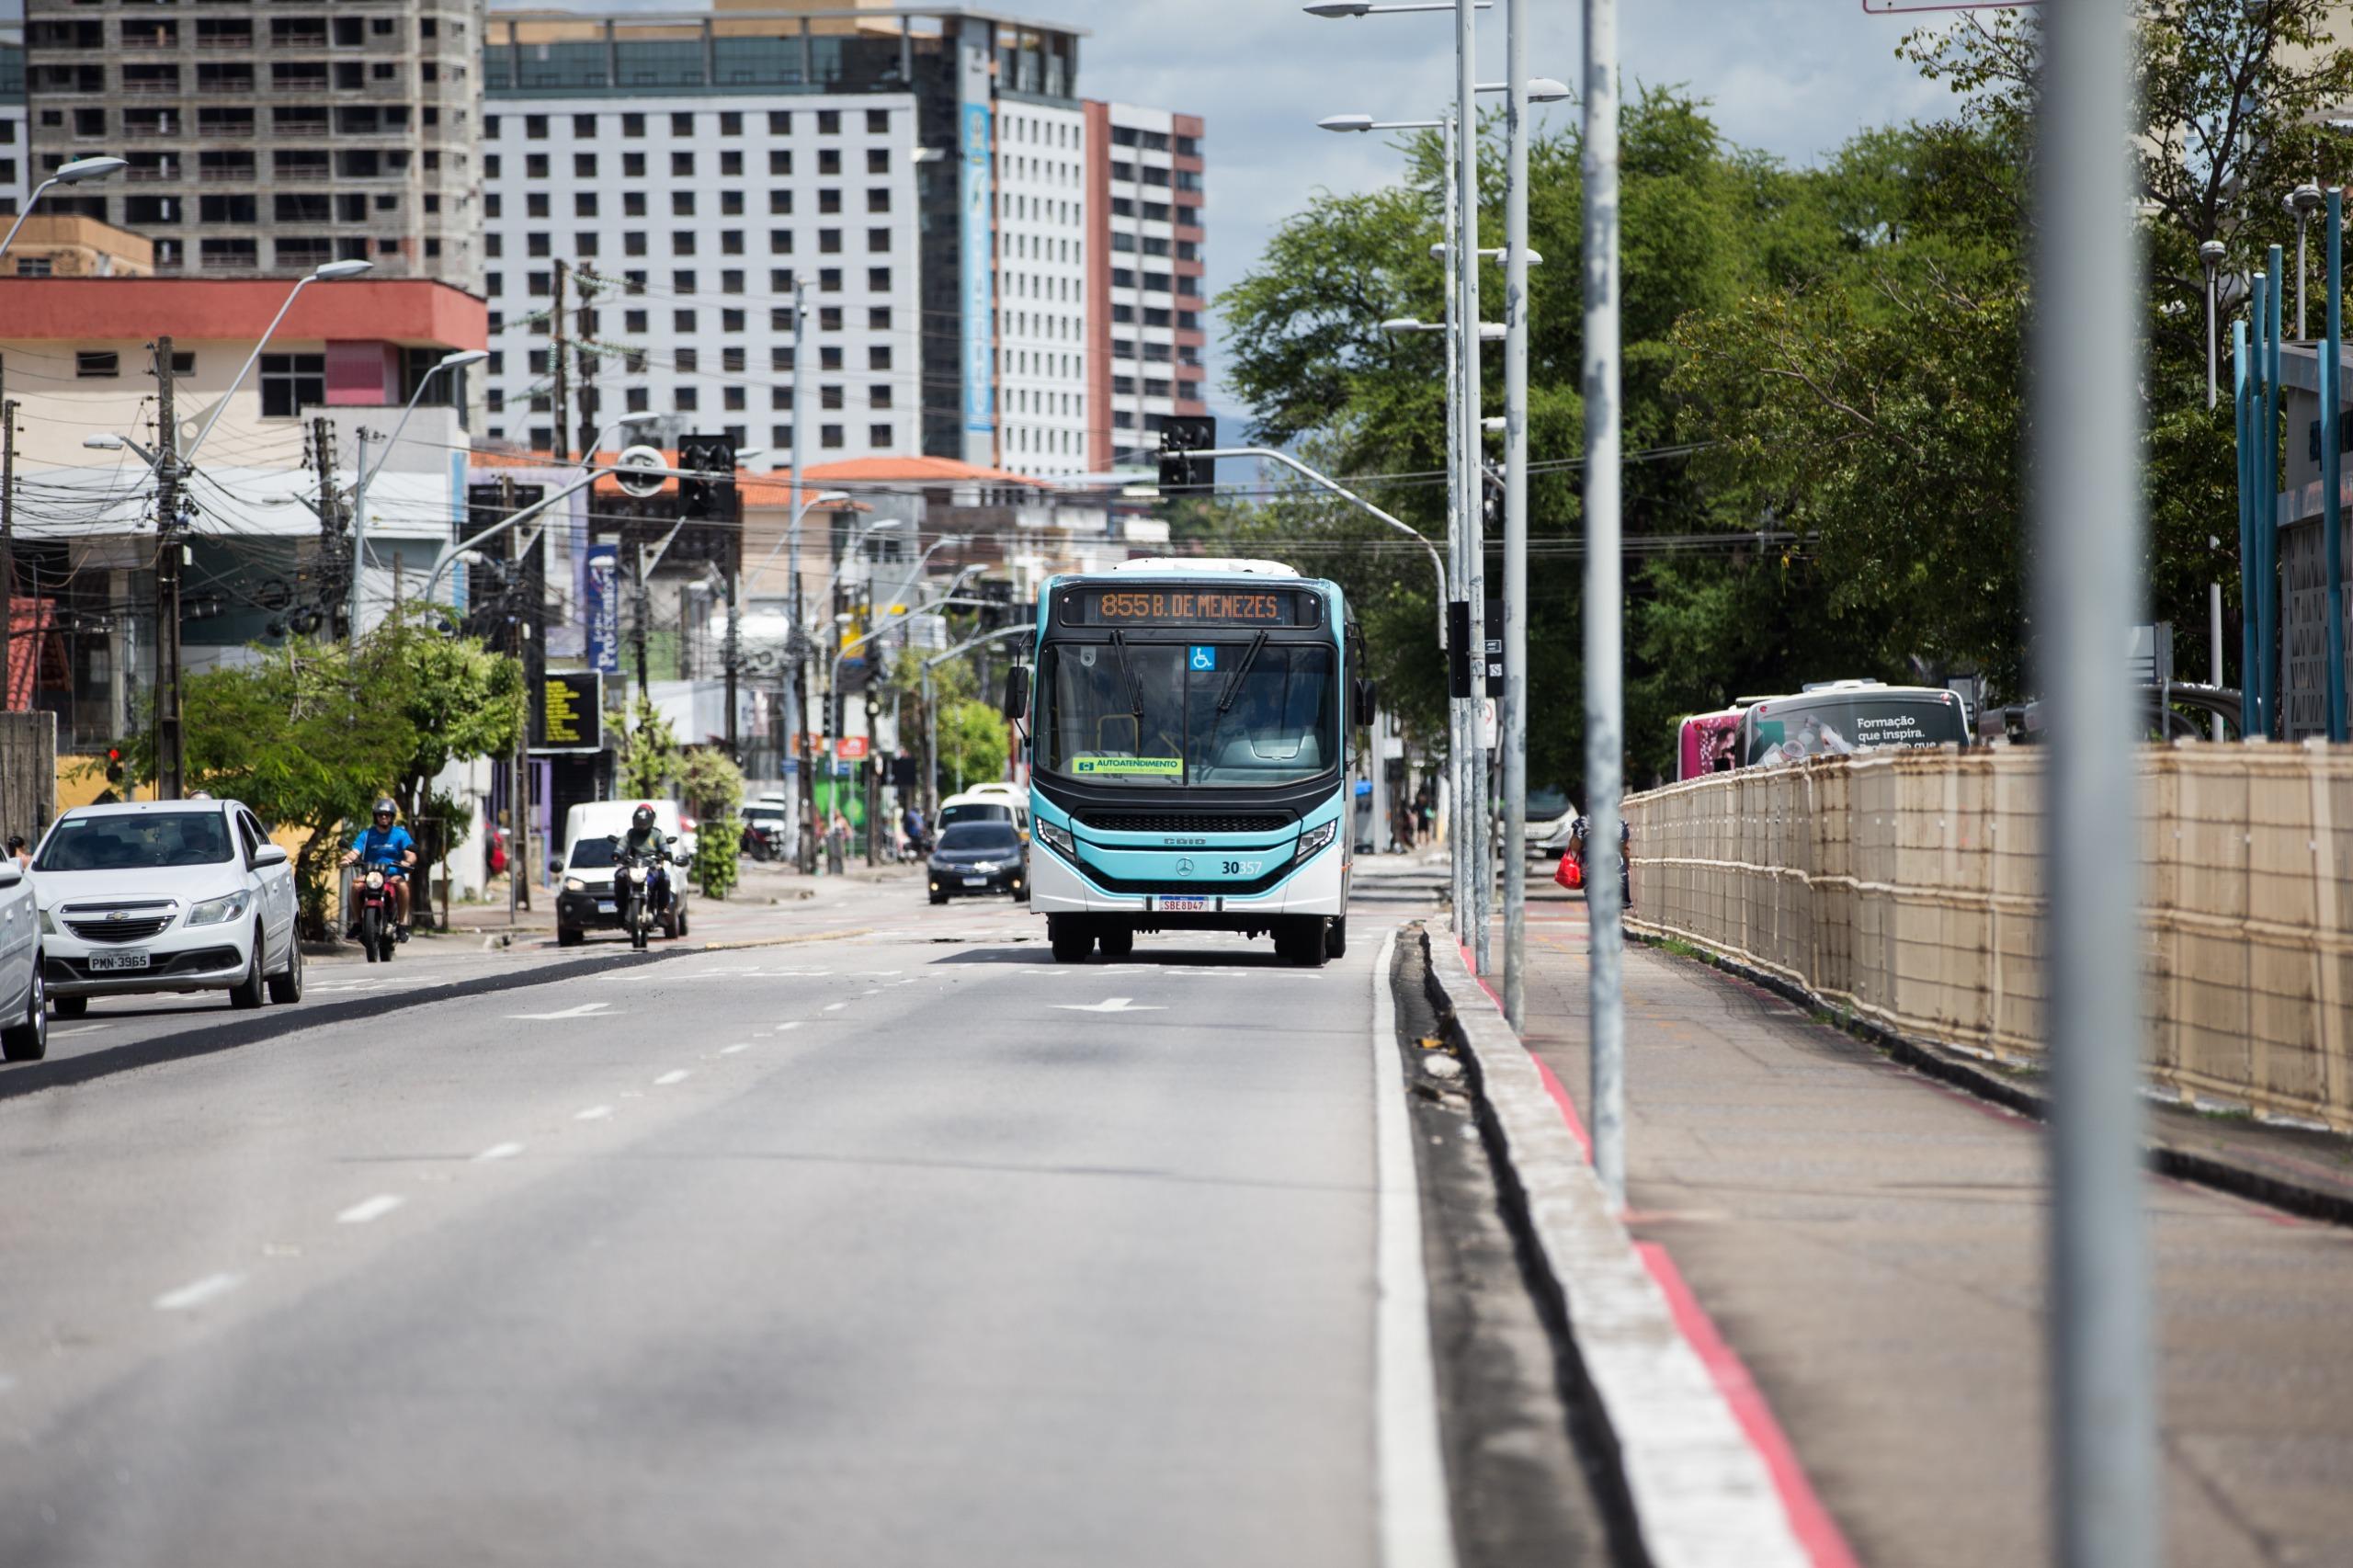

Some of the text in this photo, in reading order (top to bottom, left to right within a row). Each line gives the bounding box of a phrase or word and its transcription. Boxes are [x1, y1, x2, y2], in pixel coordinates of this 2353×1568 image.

[1101, 593, 1278, 619] 855 B. DE MENEZES
[1857, 715, 1915, 729] Formação
[1858, 728, 1926, 743] que inspira.
[1097, 759, 1177, 768] AUTOATENDIMENTO
[1222, 861, 1262, 875] 30357
